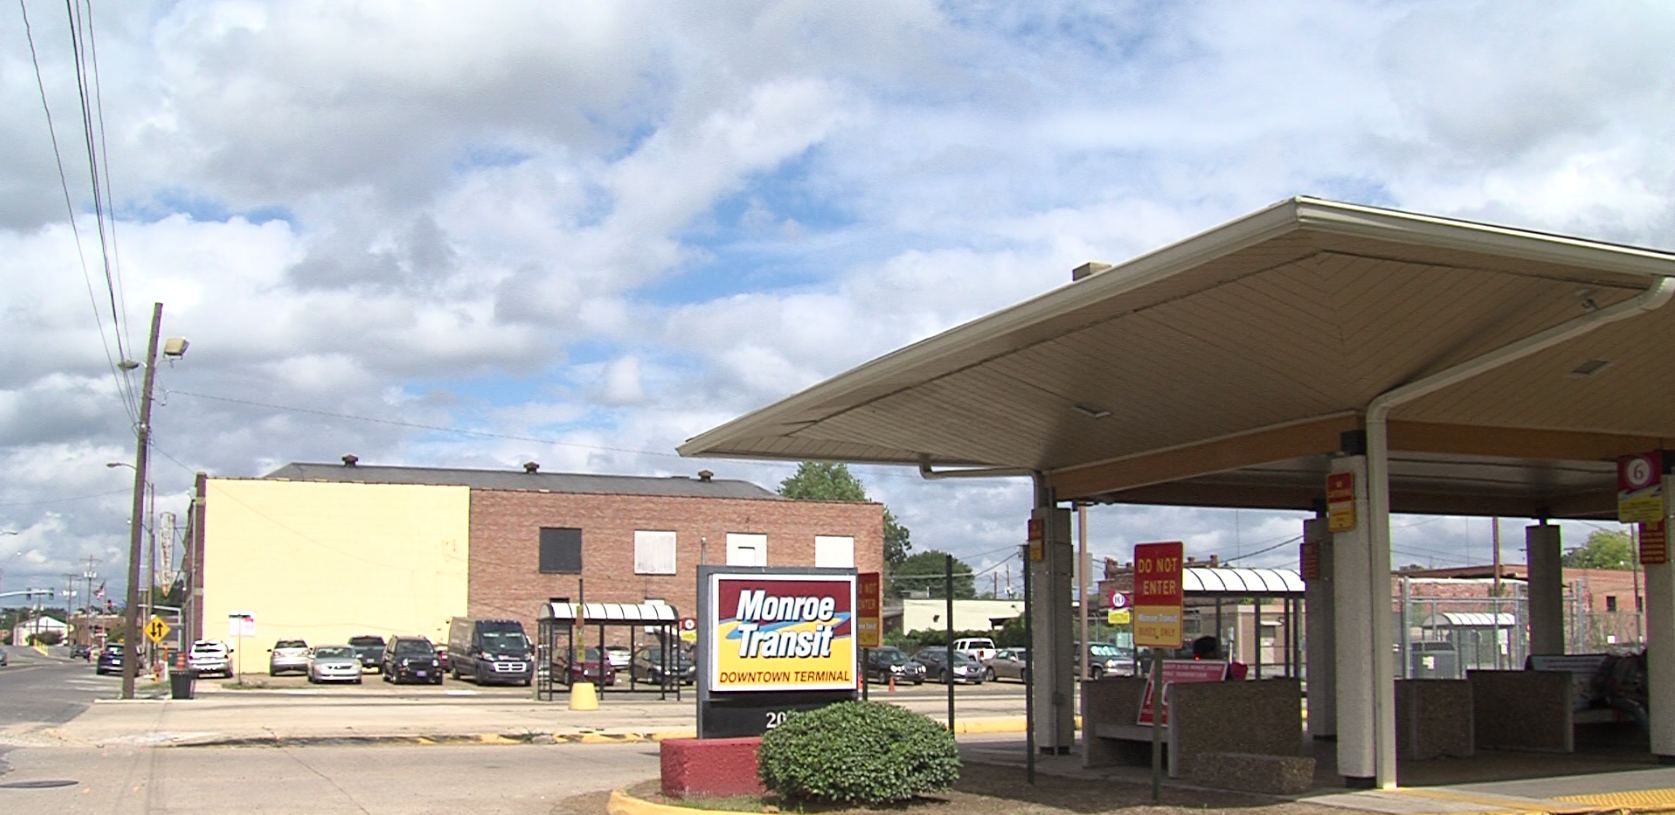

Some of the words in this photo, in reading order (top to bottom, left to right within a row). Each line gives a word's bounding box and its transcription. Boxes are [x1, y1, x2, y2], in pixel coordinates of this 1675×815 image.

[1634, 463, 1644, 479] 6
[1138, 559, 1152, 573] DO
[1156, 558, 1178, 572] NOT
[1143, 580, 1177, 595] ENTER
[736, 589, 835, 621] Monroe
[738, 623, 834, 658] Transit
[719, 671, 790, 683] DOWNTOWN
[794, 671, 850, 682] TERMINAL
